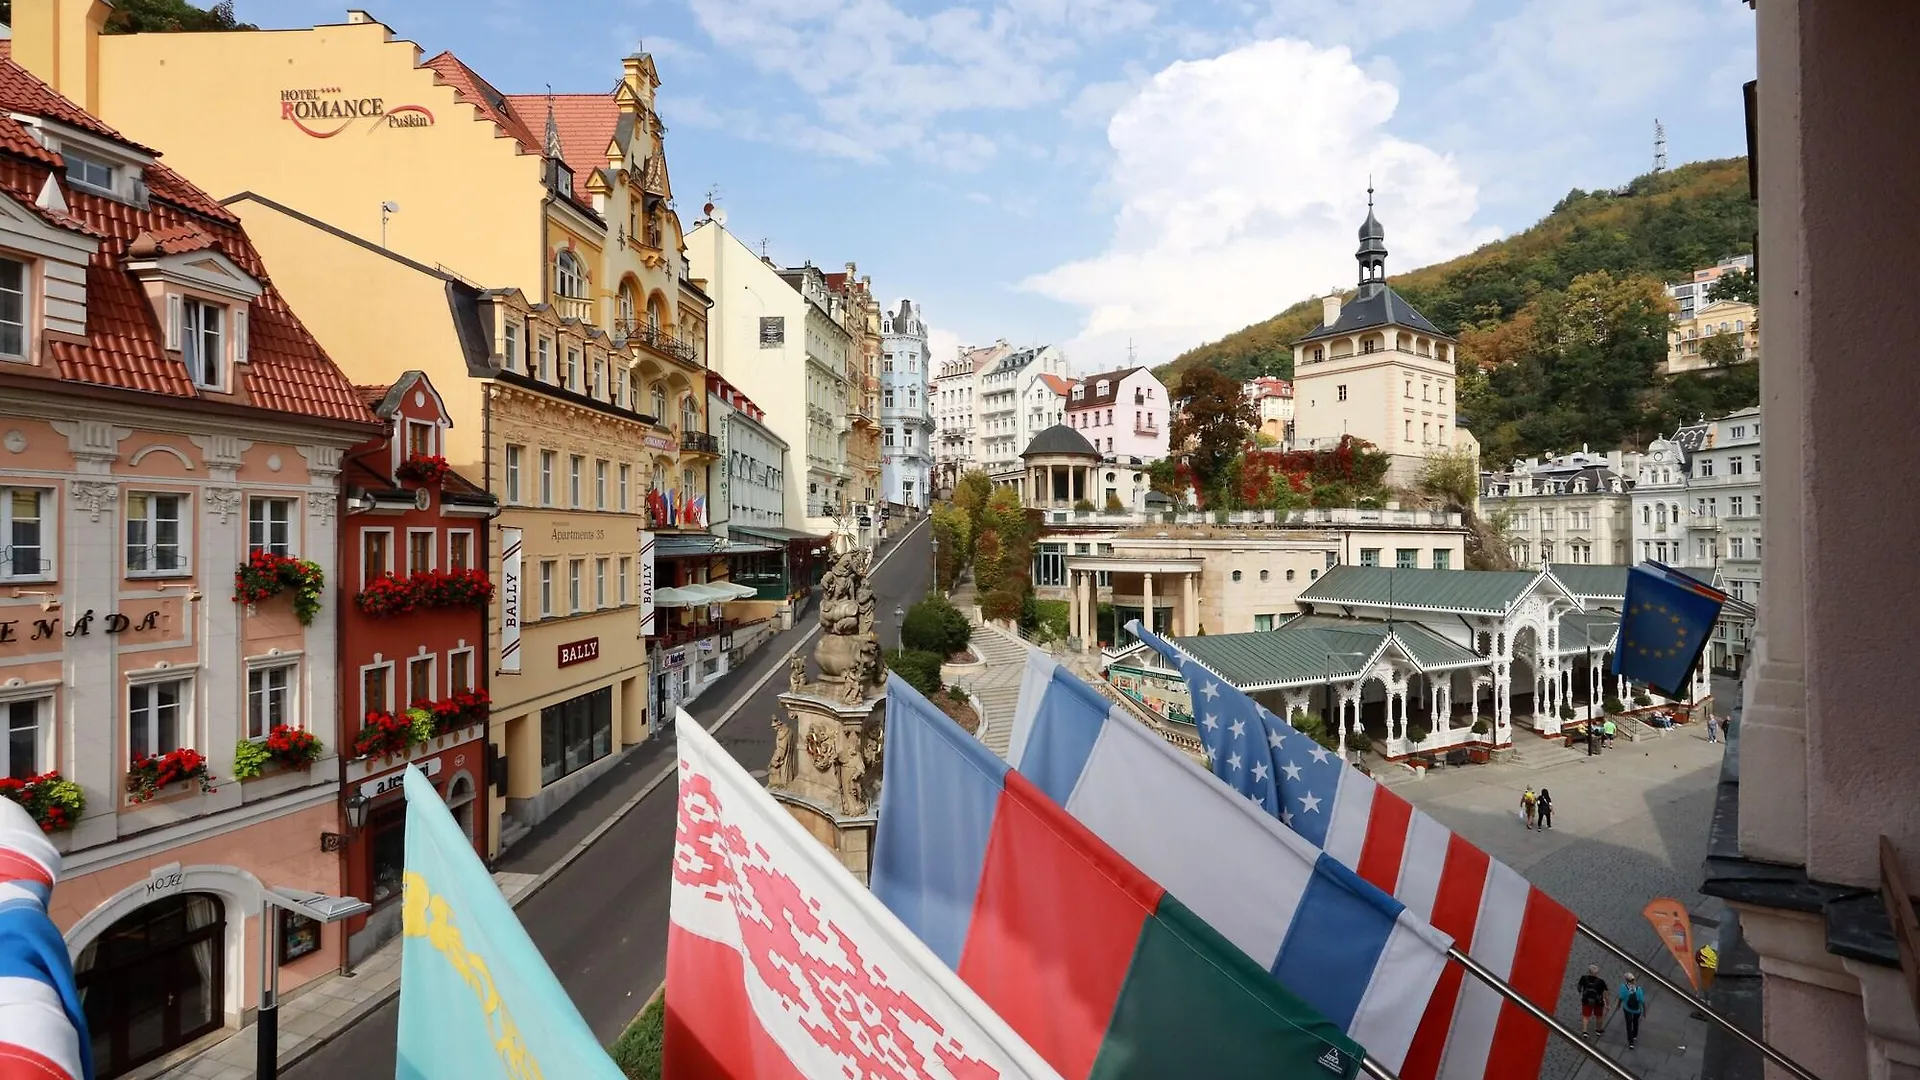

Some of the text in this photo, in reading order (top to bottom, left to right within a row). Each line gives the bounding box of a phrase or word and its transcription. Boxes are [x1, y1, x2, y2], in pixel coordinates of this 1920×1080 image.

[280, 89, 320, 101] HOTEL
[281, 98, 384, 120] ROMANCE
[388, 114, 428, 128] Puškin
[551, 529, 604, 543] Apartments 35
[644, 564, 652, 604] BALLY
[506, 573, 517, 628] BALLY
[562, 642, 597, 663] BALLY
[146, 872, 182, 896] HOTEL
